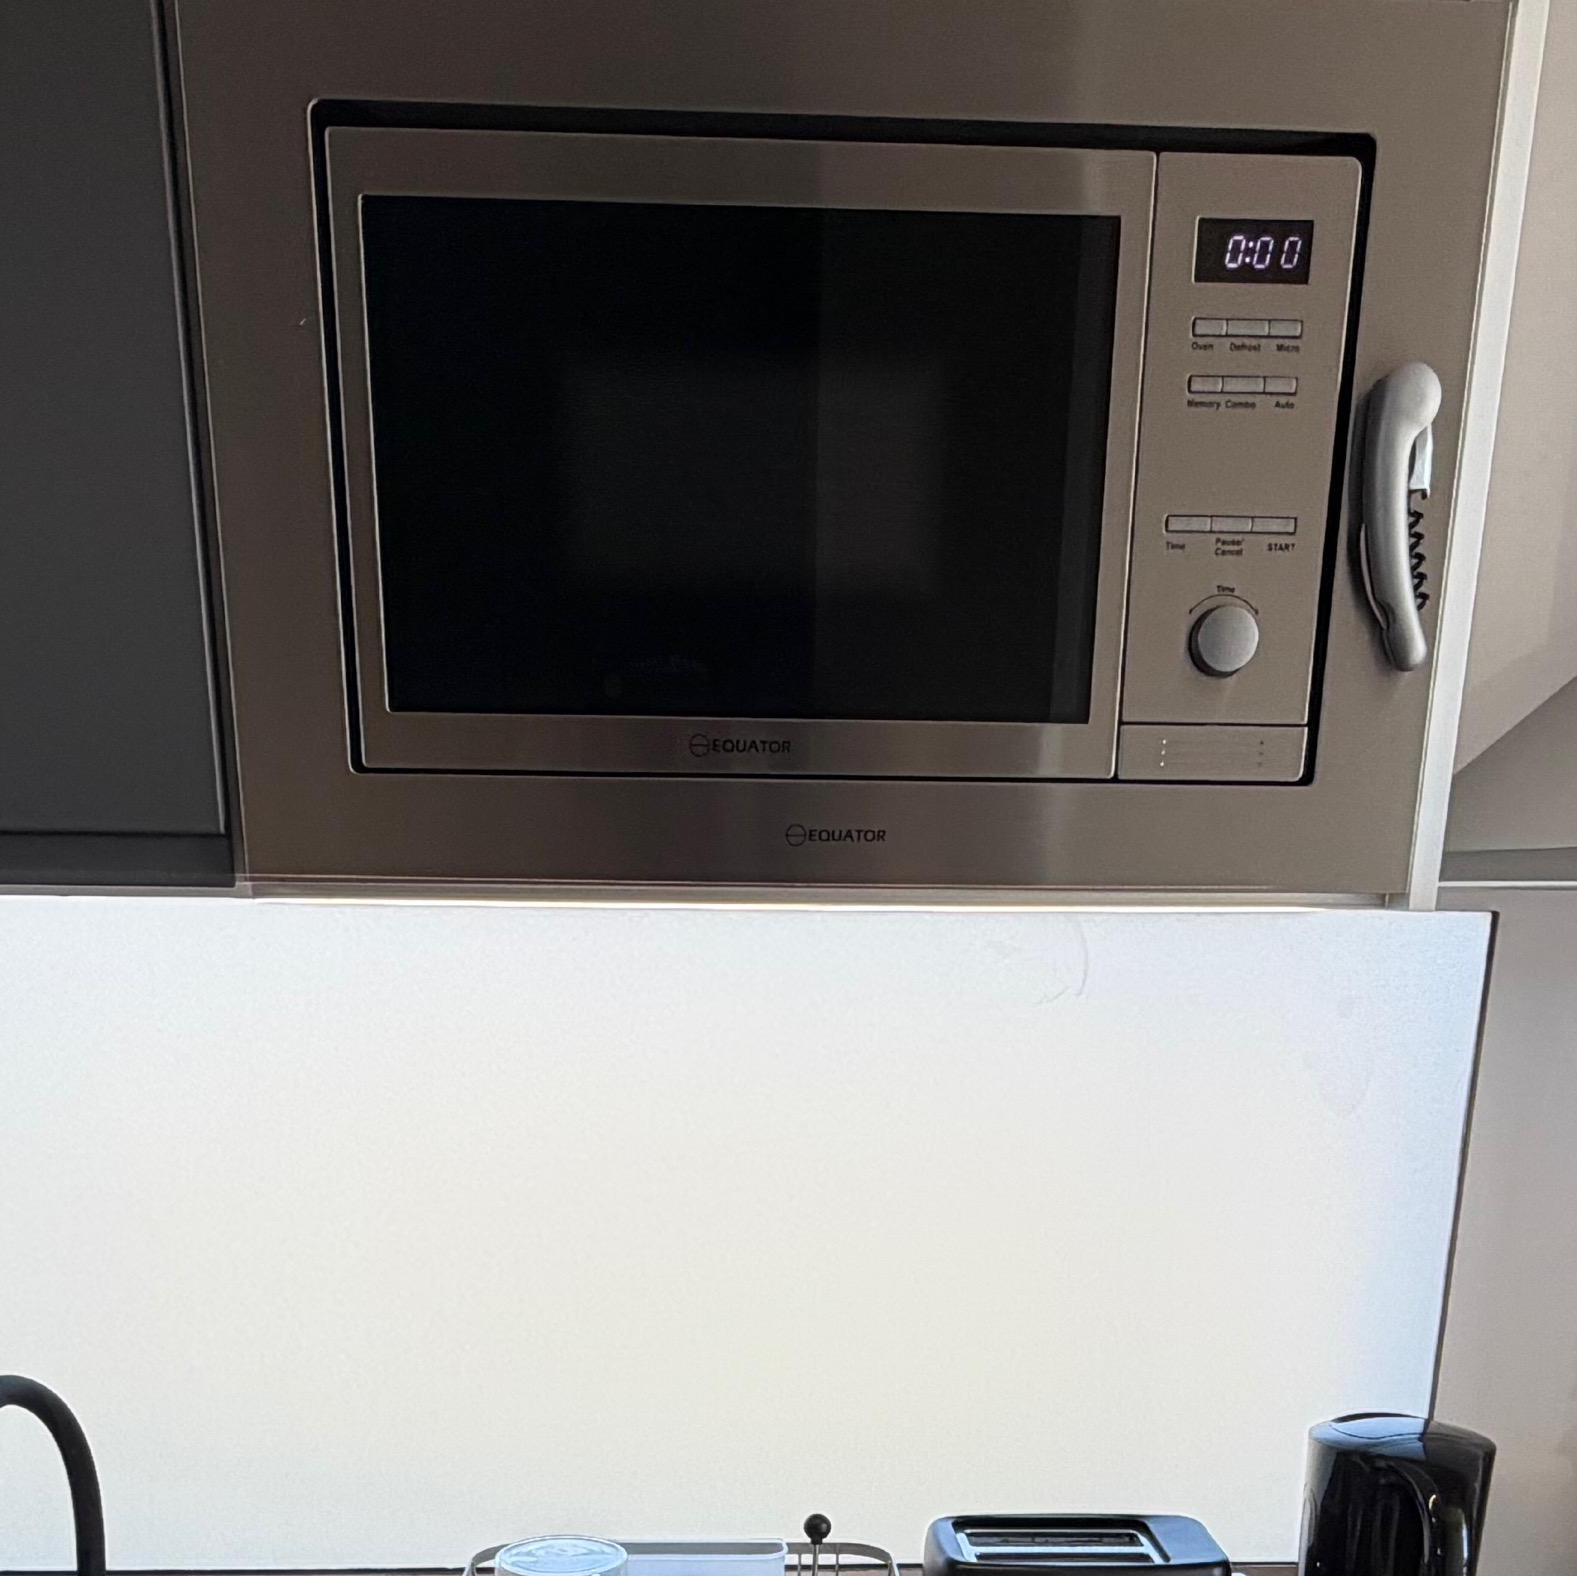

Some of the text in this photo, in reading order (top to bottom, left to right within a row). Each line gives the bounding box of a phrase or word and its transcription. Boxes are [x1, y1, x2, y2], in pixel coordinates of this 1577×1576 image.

[1225, 235, 1302, 269] 0:00
[712, 739, 791, 753] EQUATOR
[808, 829, 886, 842] EQUATOR
